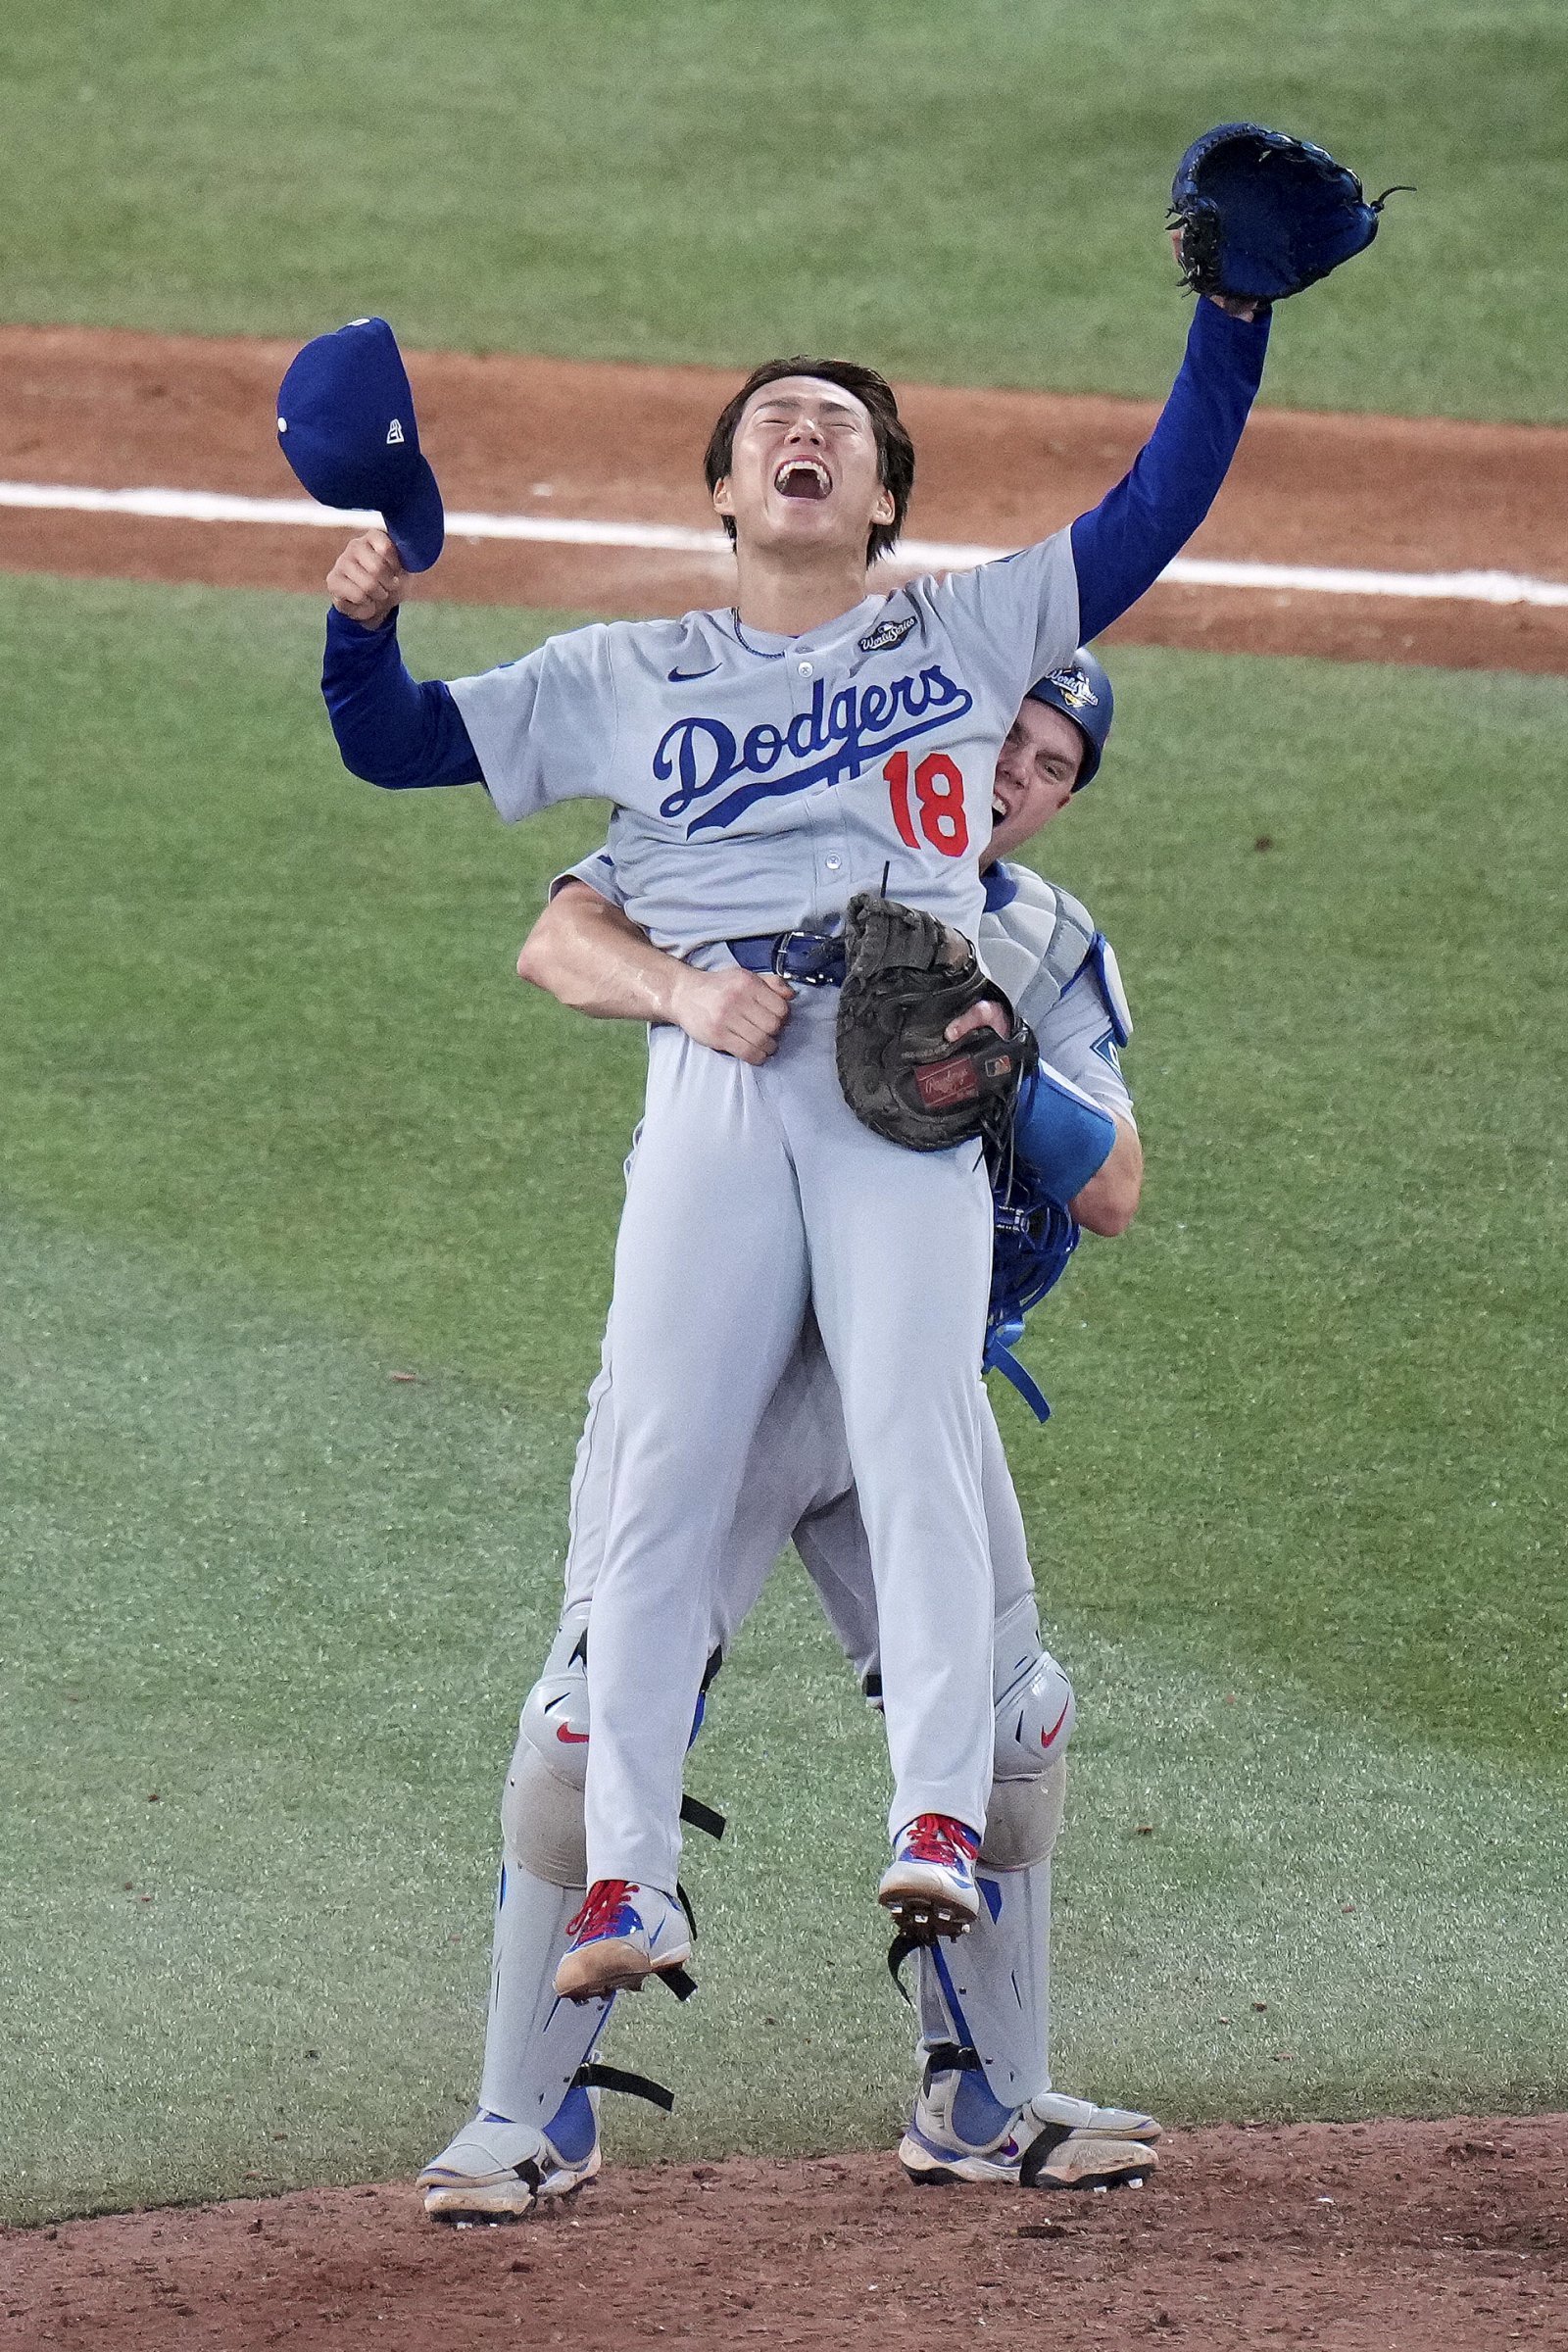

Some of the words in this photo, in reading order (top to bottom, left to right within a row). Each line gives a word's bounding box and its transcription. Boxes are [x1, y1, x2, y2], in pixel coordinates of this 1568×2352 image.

[860, 630, 891, 650] World
[887, 617, 915, 642] Series
[653, 664, 960, 818] Dodgers
[883, 751, 968, 858] 18
